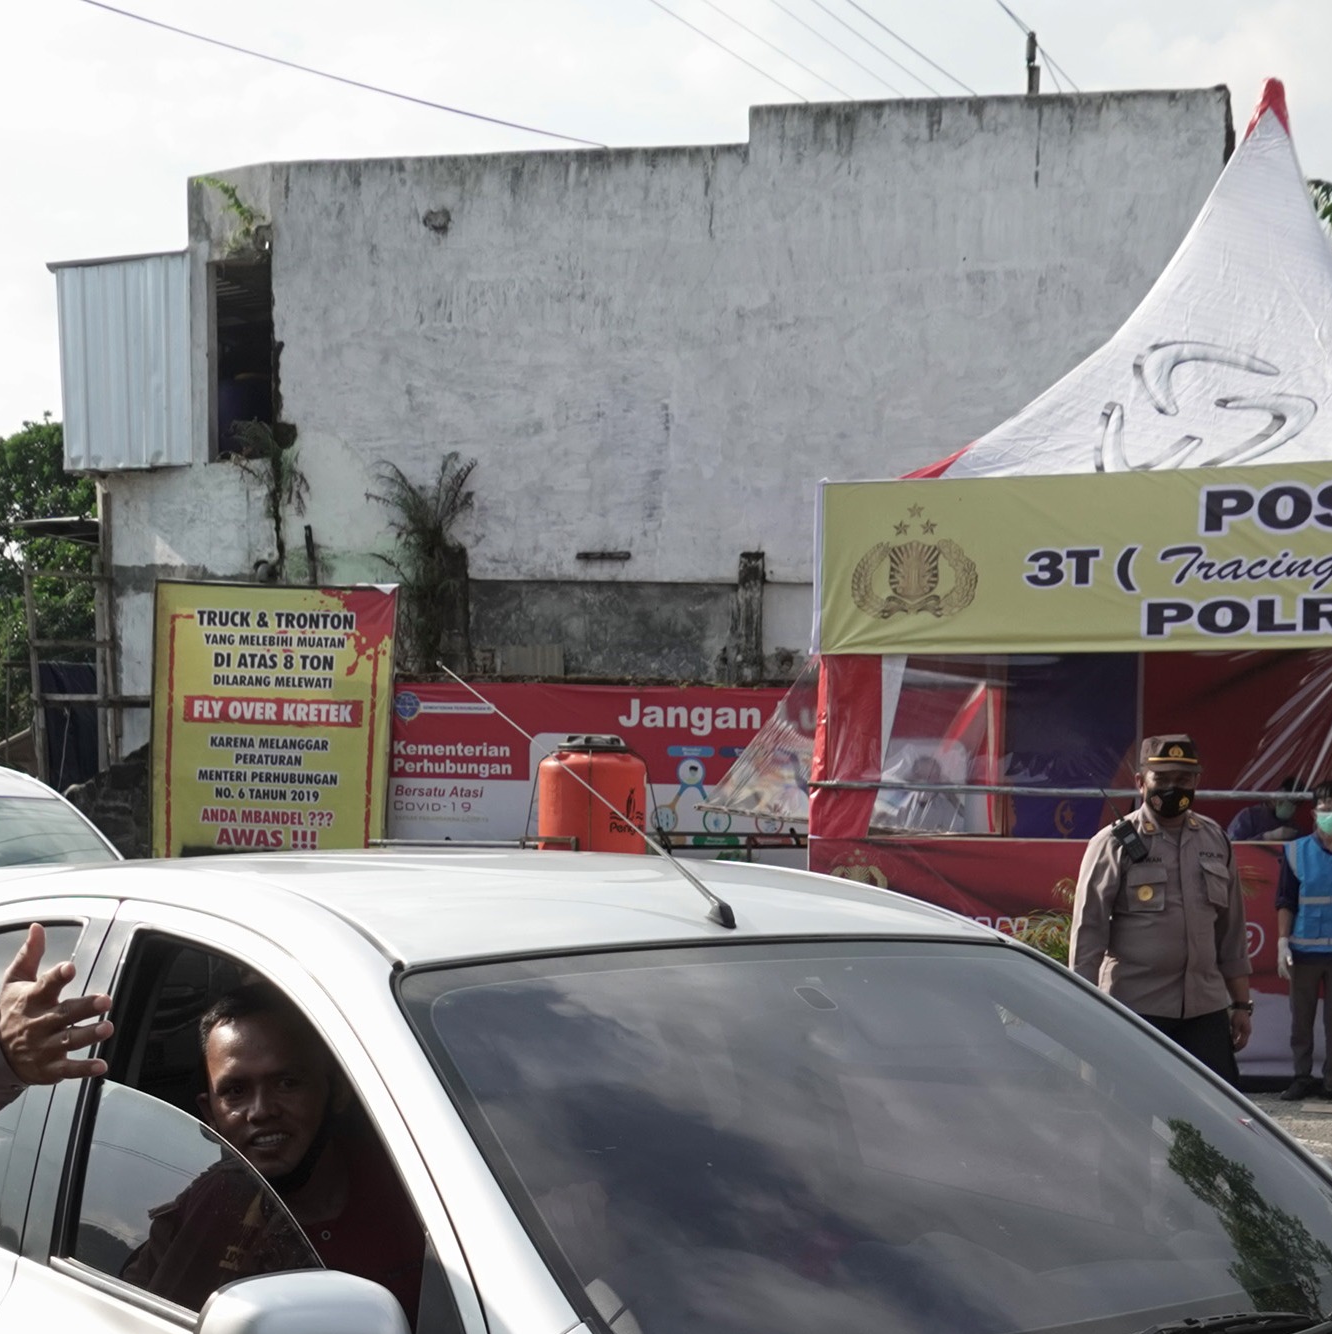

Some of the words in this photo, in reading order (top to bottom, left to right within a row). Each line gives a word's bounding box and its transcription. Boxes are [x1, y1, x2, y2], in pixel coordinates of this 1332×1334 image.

[1025, 548, 1101, 587] 3T
[197, 610, 251, 628] TRUCK
[256, 612, 269, 628] &
[275, 612, 355, 630] TRONTON
[204, 633, 235, 646] YANG
[239, 634, 293, 647] MELEBIHI
[297, 636, 345, 649] MUATAN
[214, 652, 231, 668] DI
[237, 653, 278, 669] ATAS
[283, 654, 294, 670] 8
[300, 655, 334, 671] TON
[213, 674, 271, 688] DILARANG
[274, 676, 332, 689] MELEWATI
[193, 700, 227, 719] FLY
[228, 701, 277, 720] OVER
[283, 702, 353, 723] KRETEK
[618, 698, 761, 737] Jangan
[210, 736, 255, 749] KARENA
[258, 738, 329, 751] MELANGGAR
[393, 740, 511, 758] Kementerian
[234, 753, 302, 767] PERATURAN
[393, 758, 513, 778] Perhubungan
[198, 769, 247, 782] MENTERI
[251, 772, 338, 785] PERHUBUNGAN
[215, 787, 234, 799] NO.
[238, 788, 245, 800] 6
[249, 788, 287, 801] TAHUN
[291, 789, 320, 802] 2019
[394, 784, 446, 798] Bersatu
[449, 786, 485, 799] Atasi
[393, 800, 472, 812] COVID-19
[201, 808, 237, 823] ANDA
[241, 809, 304, 826] MBANDEL
[308, 811, 334, 827] ???
[217, 828, 283, 848] AWAS
[291, 830, 317, 850] !!!
